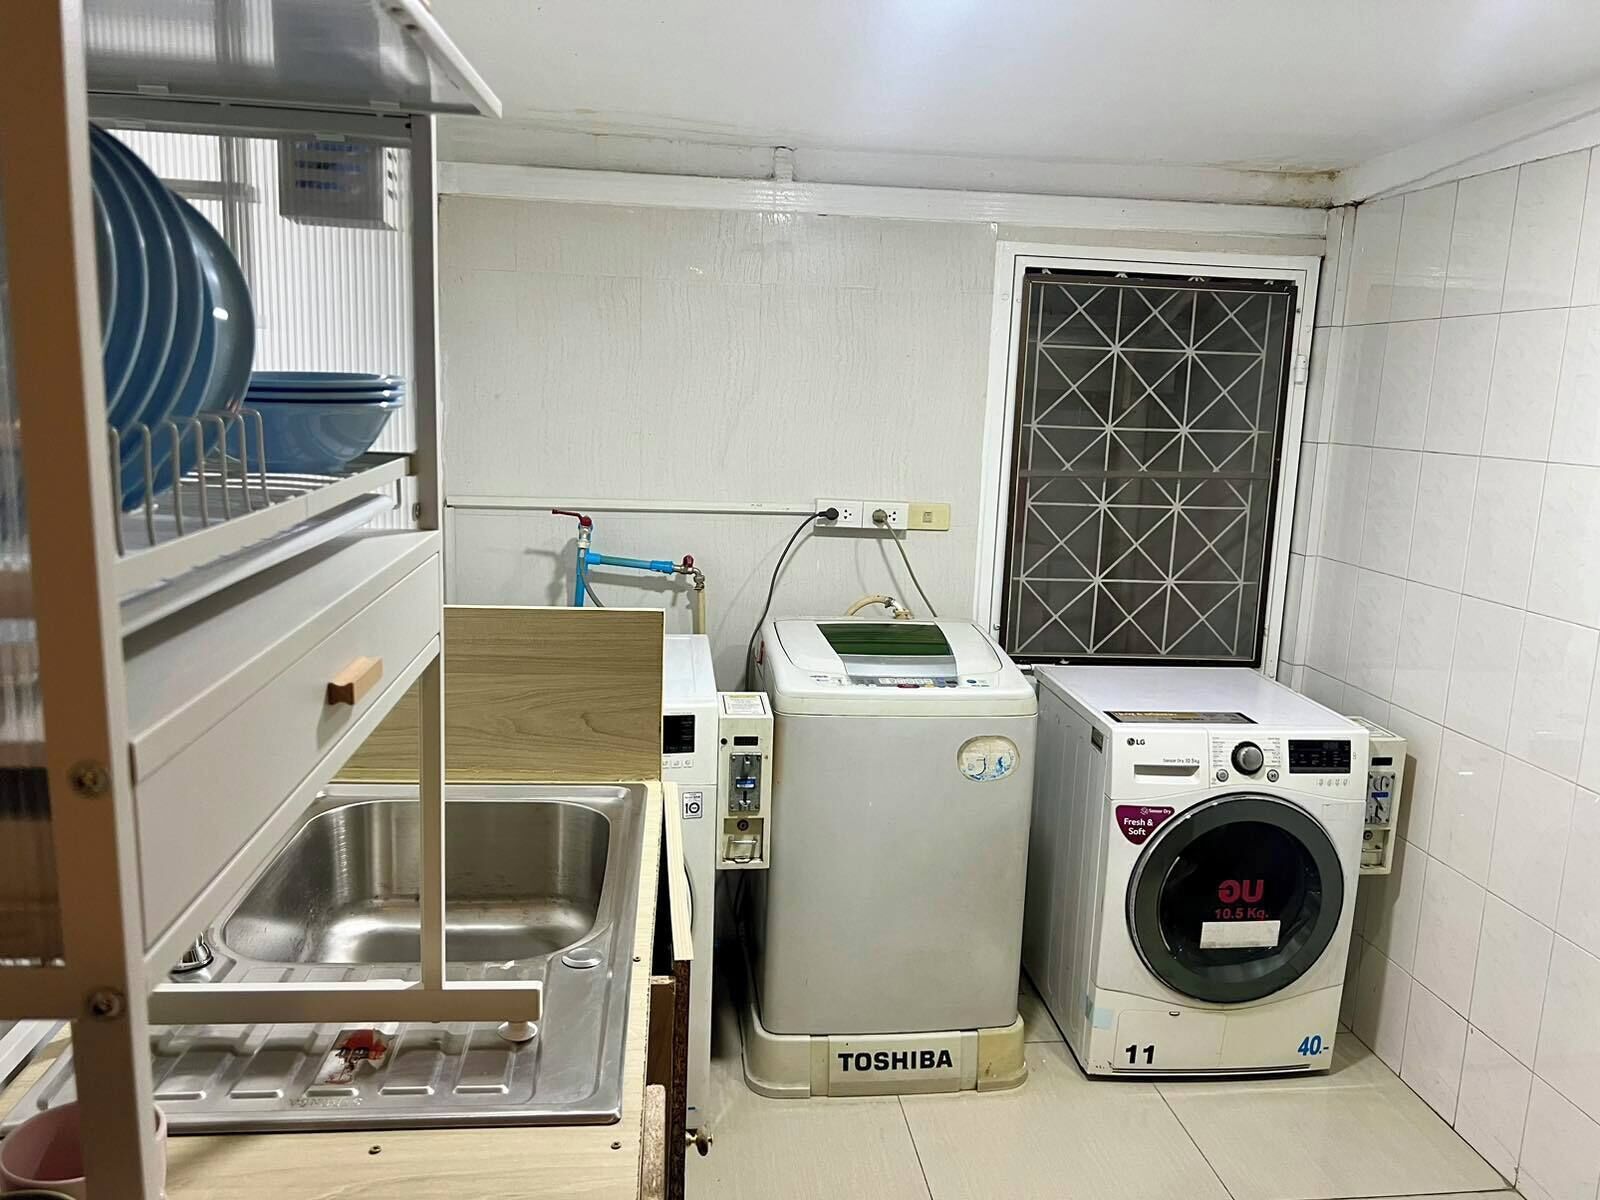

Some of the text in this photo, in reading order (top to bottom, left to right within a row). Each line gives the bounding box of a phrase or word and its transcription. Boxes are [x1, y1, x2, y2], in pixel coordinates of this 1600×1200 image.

[1123, 817, 1154, 827] Fresh &
[1128, 827, 1147, 836] Soft
[1215, 907, 1270, 923] 10.5 Kg.
[837, 1049, 954, 1072] TOSHIBA
[1125, 1044, 1156, 1065] 11
